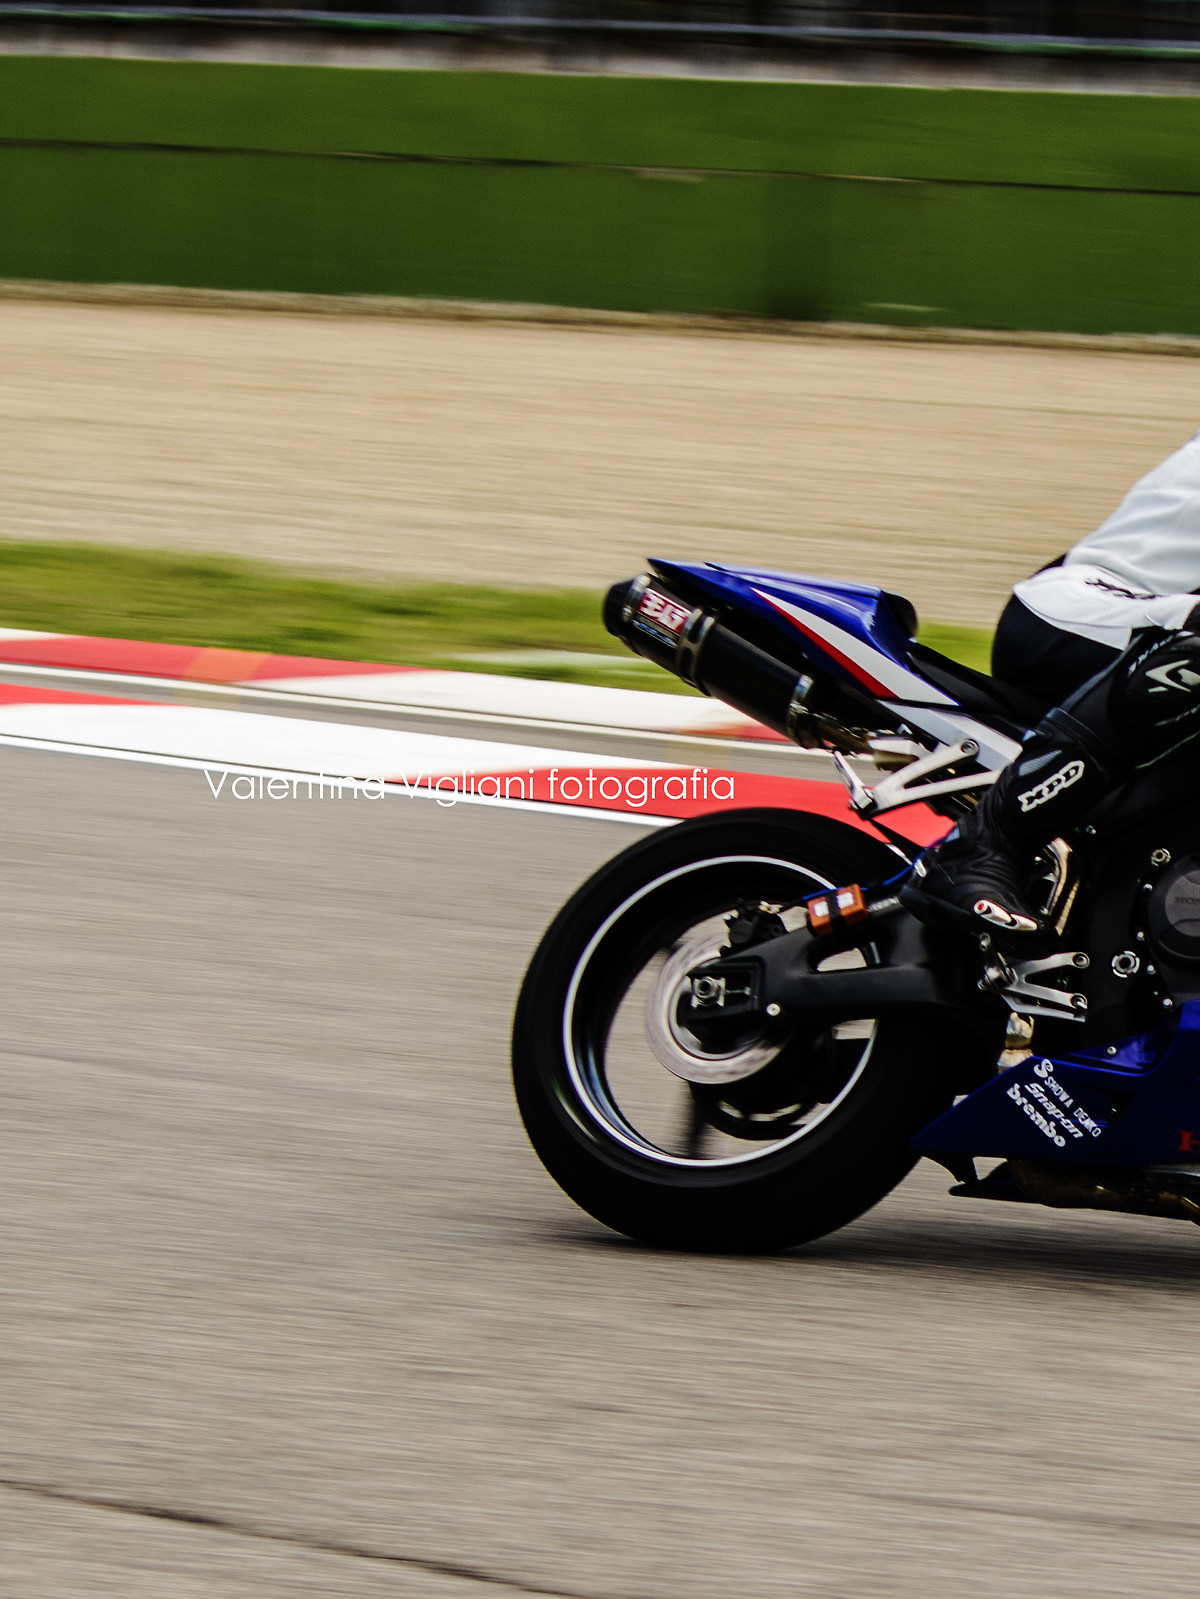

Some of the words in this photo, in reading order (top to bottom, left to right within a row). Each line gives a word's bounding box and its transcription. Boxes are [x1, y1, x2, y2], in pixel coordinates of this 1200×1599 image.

[1006, 1083, 1066, 1147] brembo
[1024, 1082, 1083, 1138] Snap-on
[1044, 1076, 1074, 1108] SHOWA
